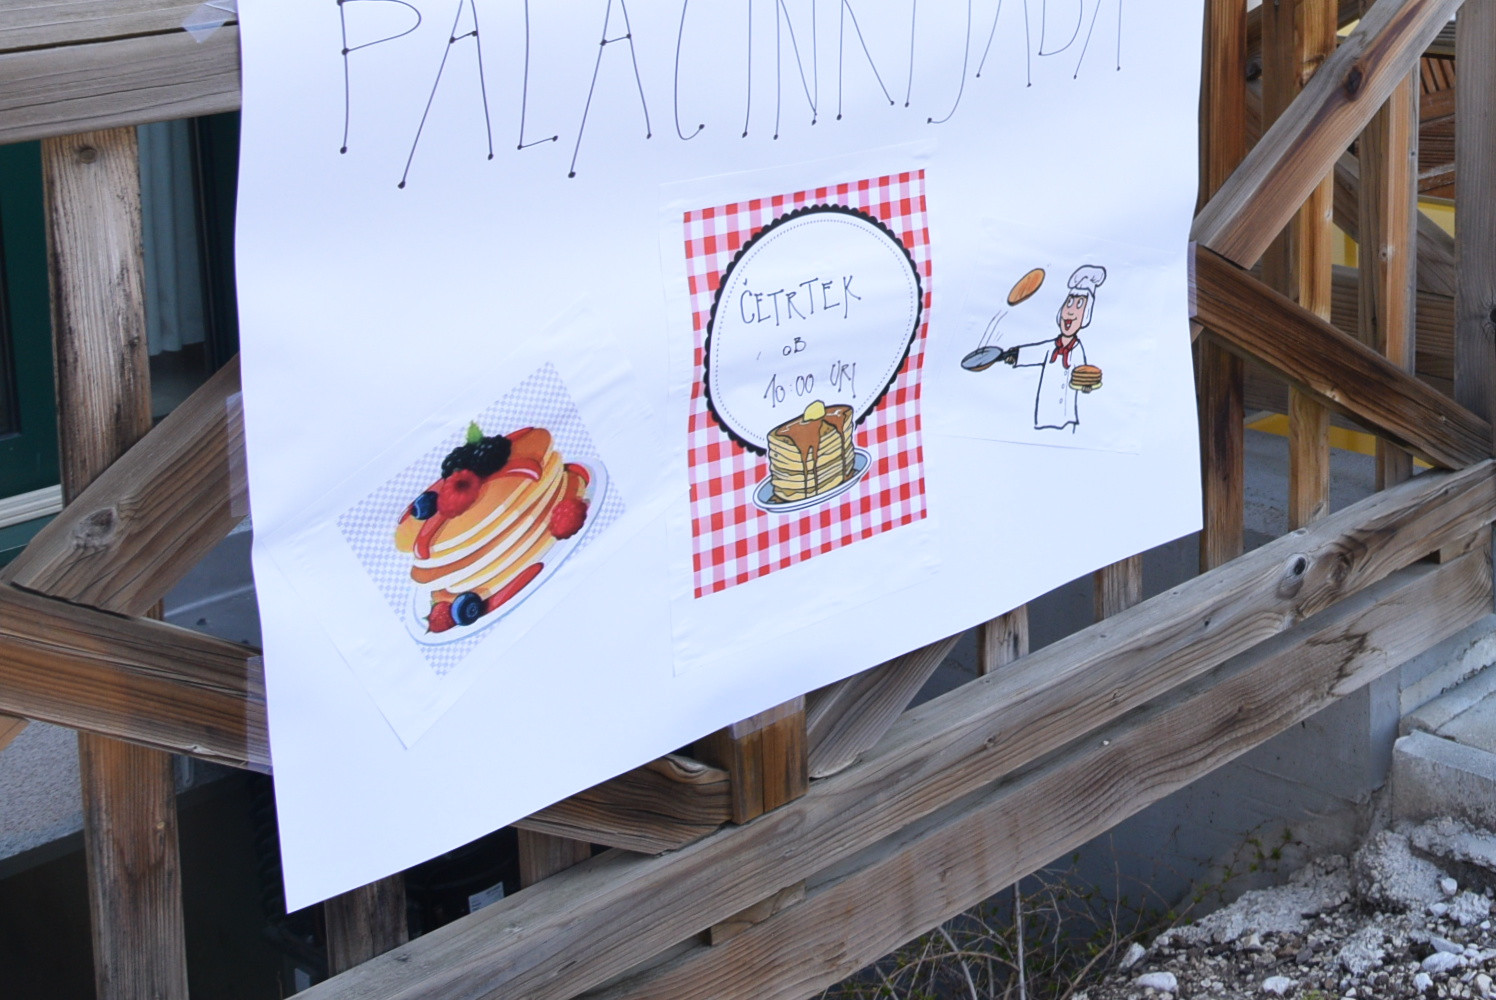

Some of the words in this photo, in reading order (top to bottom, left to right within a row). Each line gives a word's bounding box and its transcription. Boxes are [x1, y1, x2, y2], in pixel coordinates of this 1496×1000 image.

[740, 275, 861, 325] ČETRTEK
[763, 373, 814, 408] 10:00
[829, 360, 857, 399] URI
